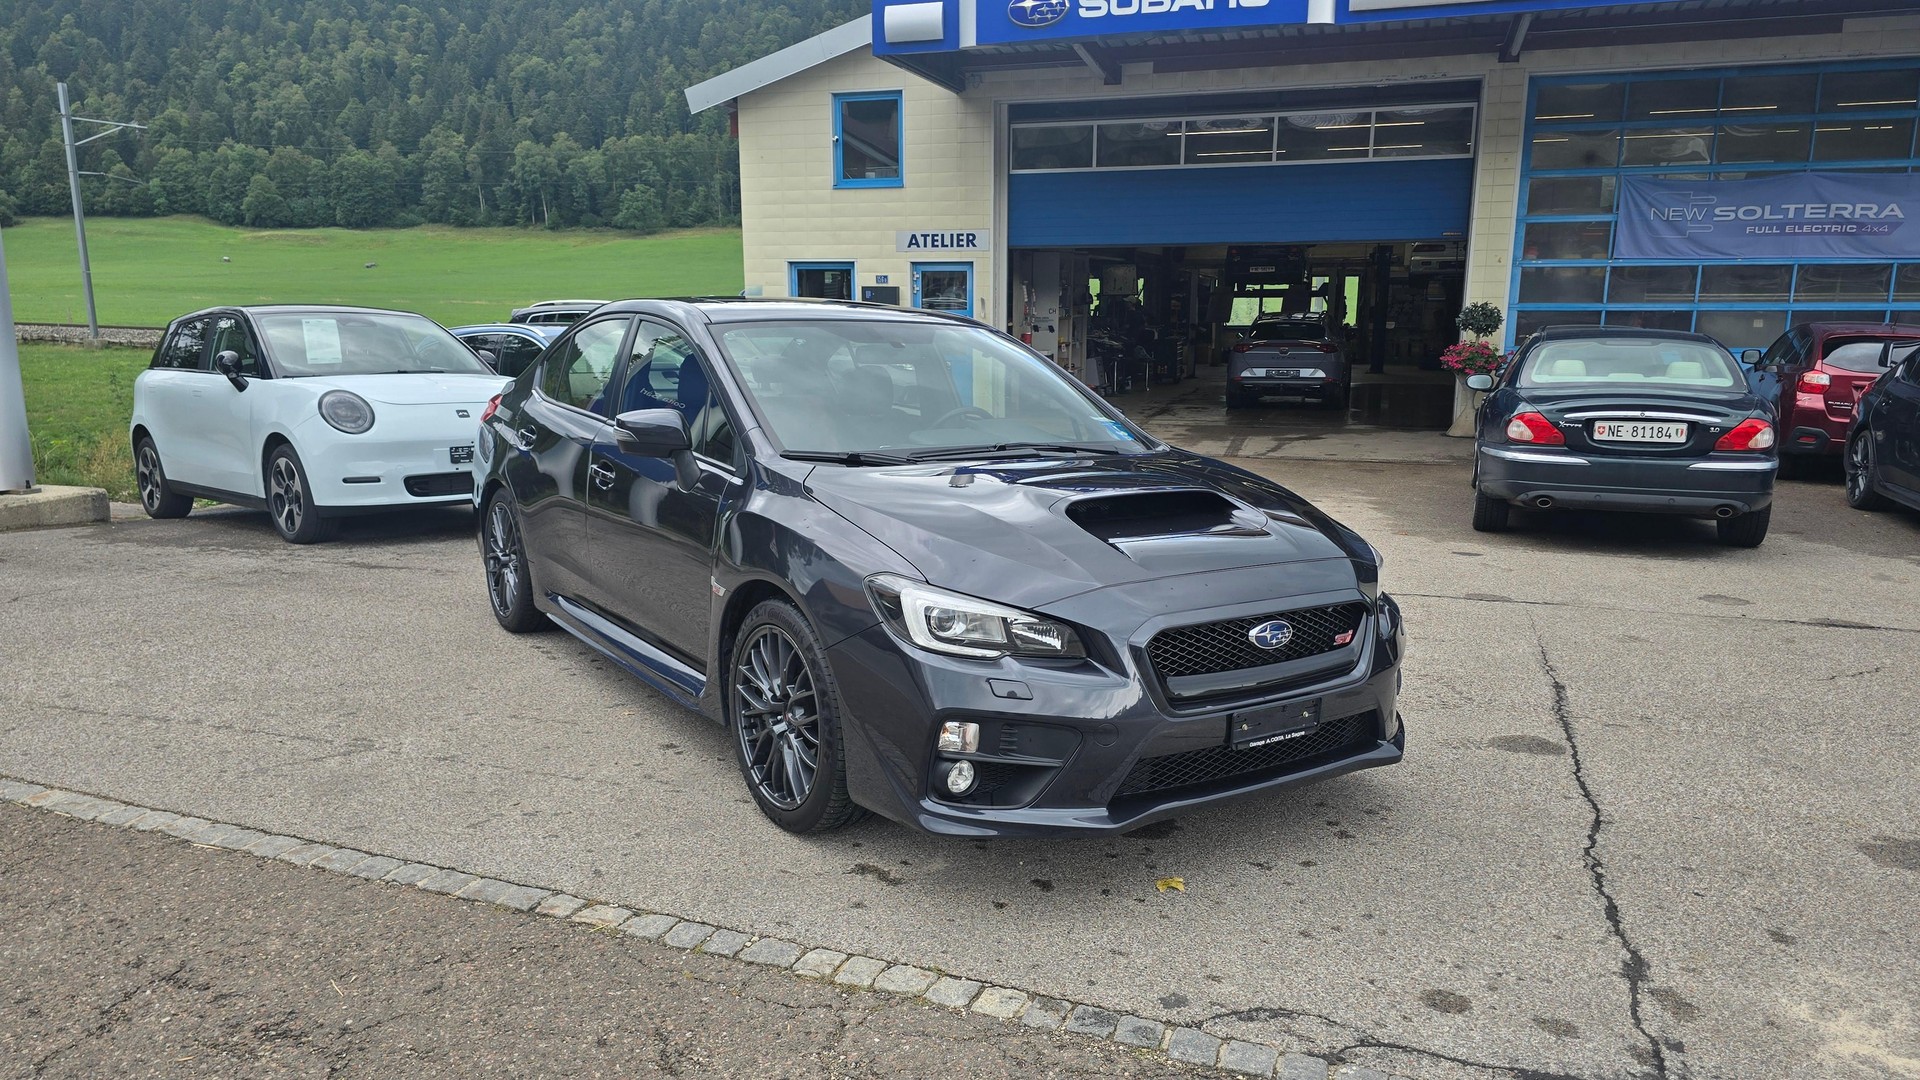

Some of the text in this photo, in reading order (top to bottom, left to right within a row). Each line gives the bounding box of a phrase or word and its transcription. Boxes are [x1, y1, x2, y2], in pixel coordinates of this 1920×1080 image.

[1078, 0, 1270, 18] SUB
[1651, 203, 1905, 222] NEW SOLTERRA
[1746, 225, 1889, 234] FULL ELECTRIC 4x4
[907, 233, 977, 248] ATELIER
[1631, 425, 1672, 439] 81184
